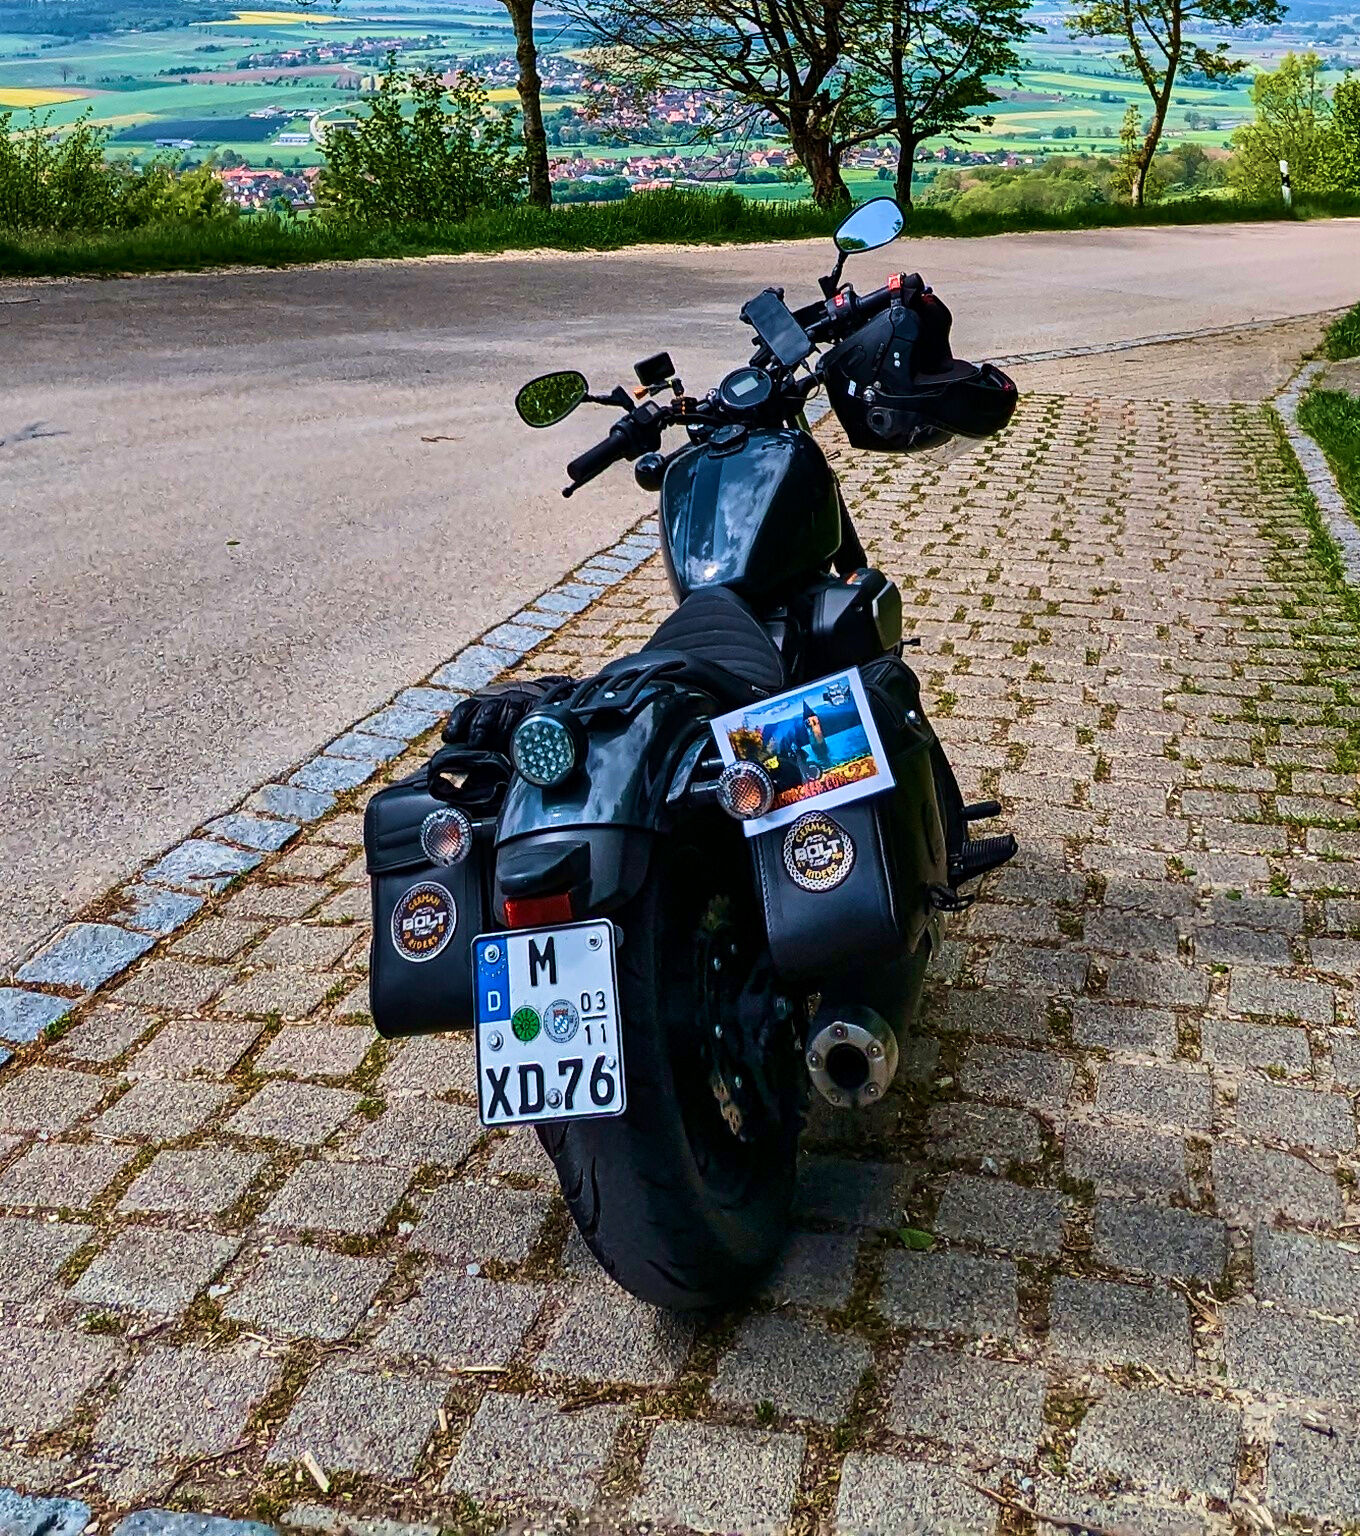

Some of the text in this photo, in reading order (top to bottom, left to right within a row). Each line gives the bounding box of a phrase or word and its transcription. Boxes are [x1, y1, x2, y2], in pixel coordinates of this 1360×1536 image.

[794, 839, 841, 861] BOLT
[402, 911, 447, 931] BOLT
[527, 936, 557, 987] M
[487, 990, 501, 1012] D
[580, 990, 606, 1013] 03
[583, 1022, 607, 1046] 11
